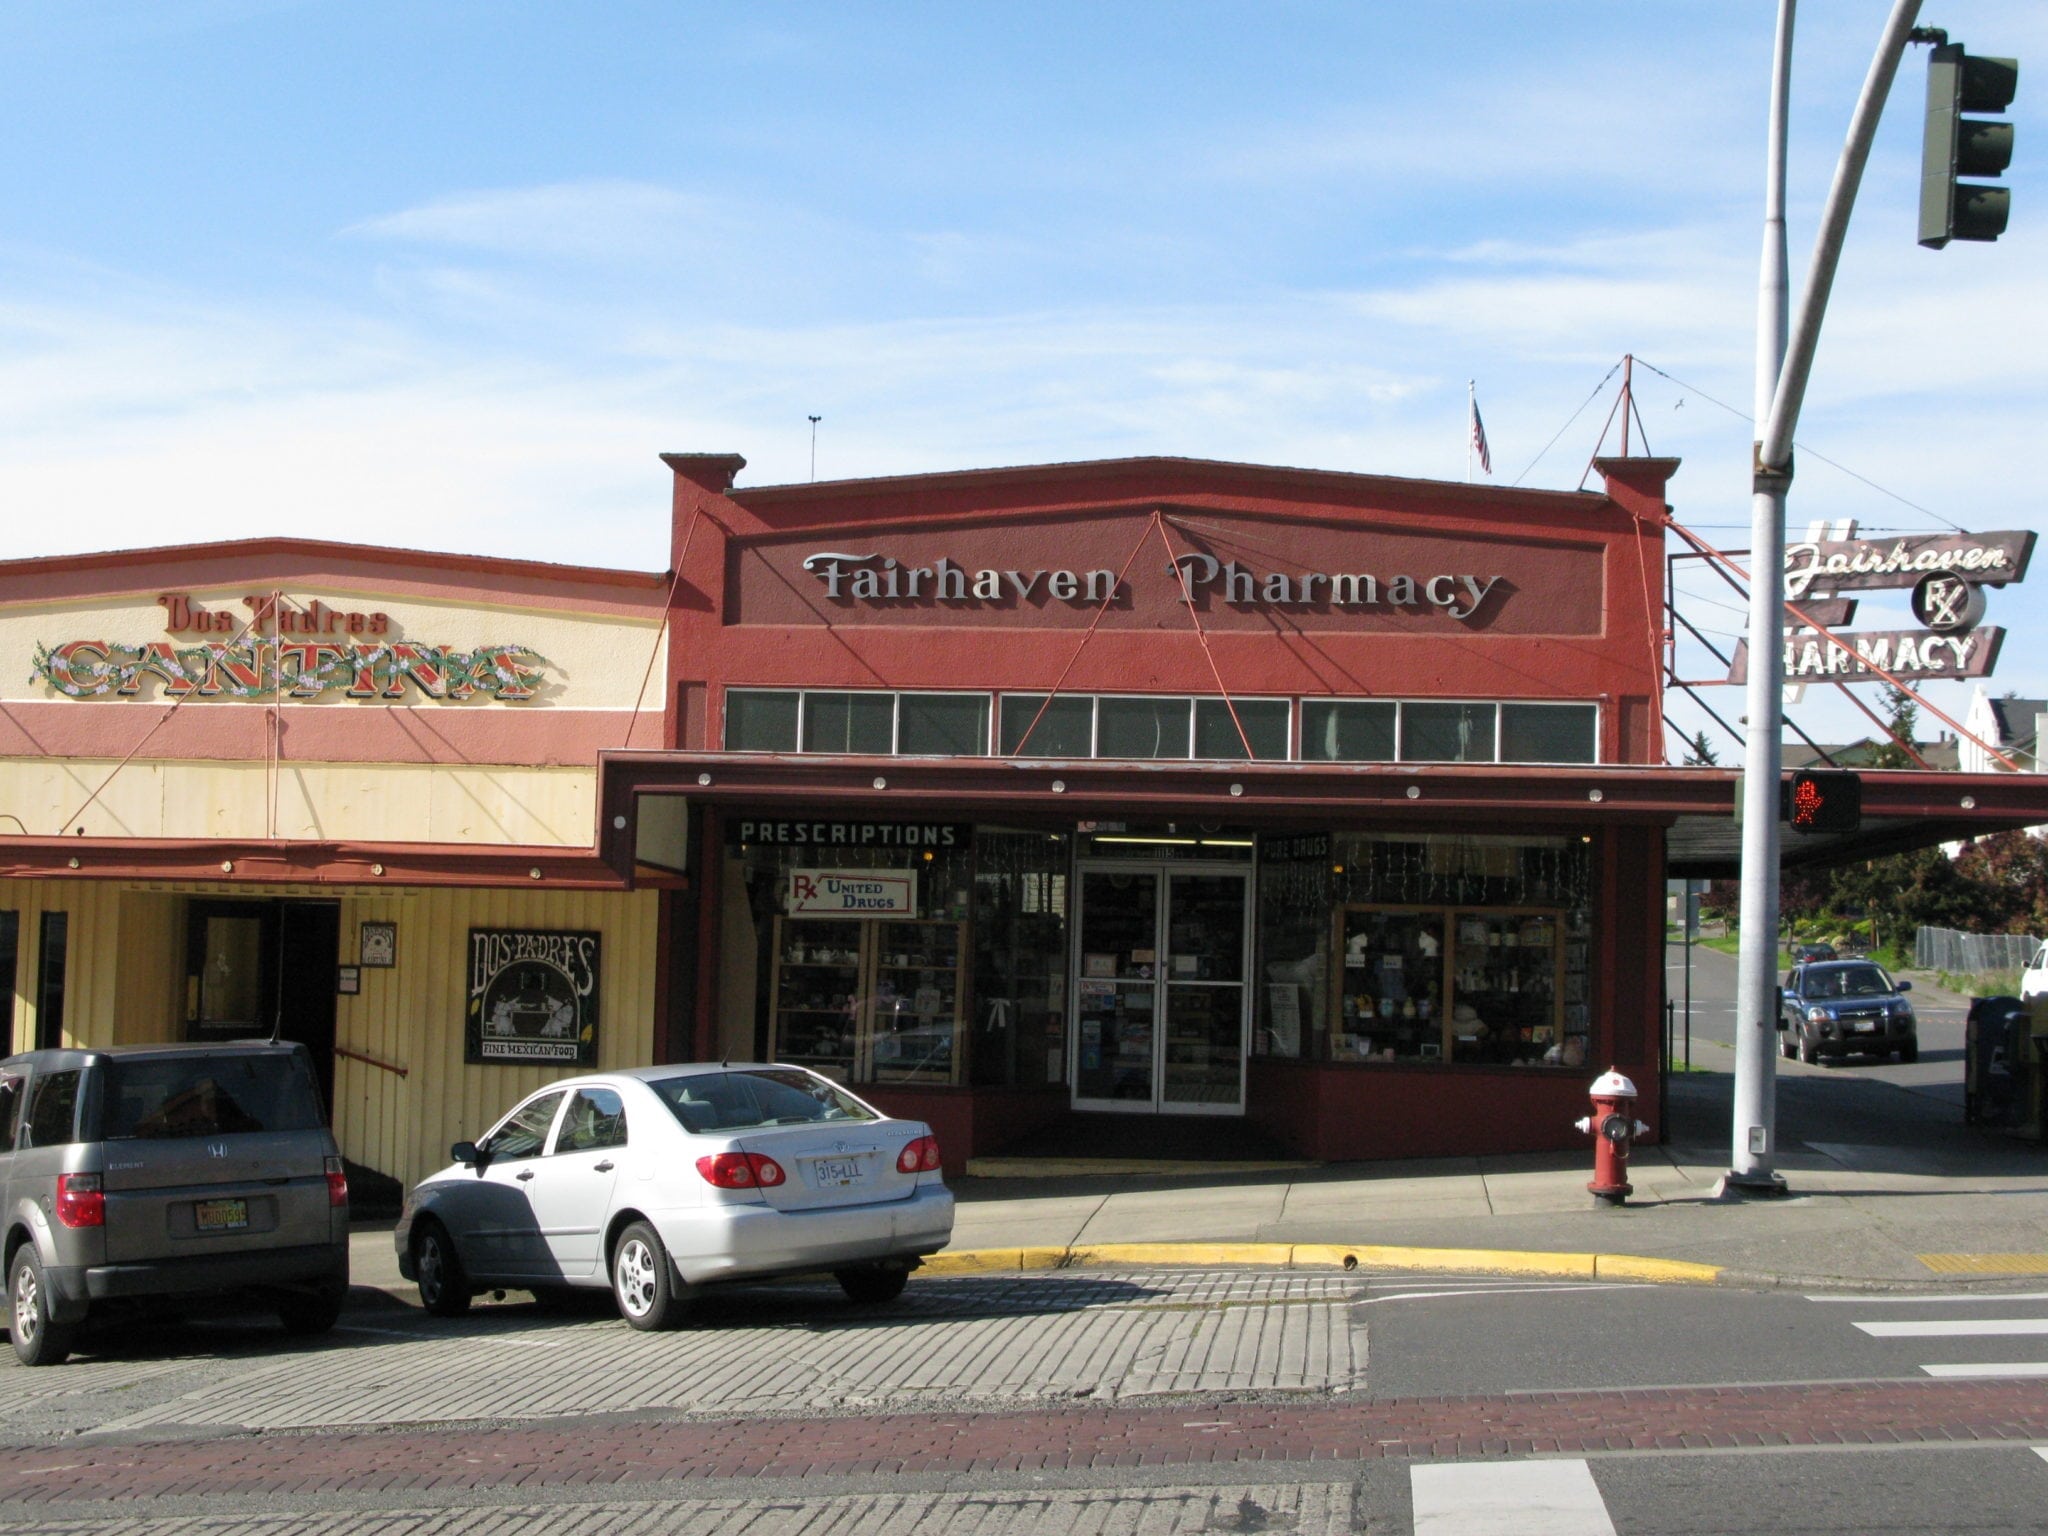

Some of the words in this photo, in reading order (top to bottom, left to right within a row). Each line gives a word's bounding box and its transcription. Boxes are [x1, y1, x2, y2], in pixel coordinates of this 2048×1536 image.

[802, 552, 1121, 600] Fairhaven
[1166, 553, 1501, 619] Pharmacy
[158, 593, 234, 633] Dos
[242, 593, 388, 634] Padres
[50, 640, 538, 700] CANTINA
[1784, 635, 1975, 676] ARMACY
[741, 822, 955, 846] PRESCRIPTIONS
[1293, 836, 1327, 857] DRUGS
[471, 932, 512, 997] DOS
[514, 933, 595, 997] PADRES
[483, 1043, 506, 1055] FINE
[508, 1043, 552, 1056] MEXICAN
[553, 1044, 576, 1058] FOOD
